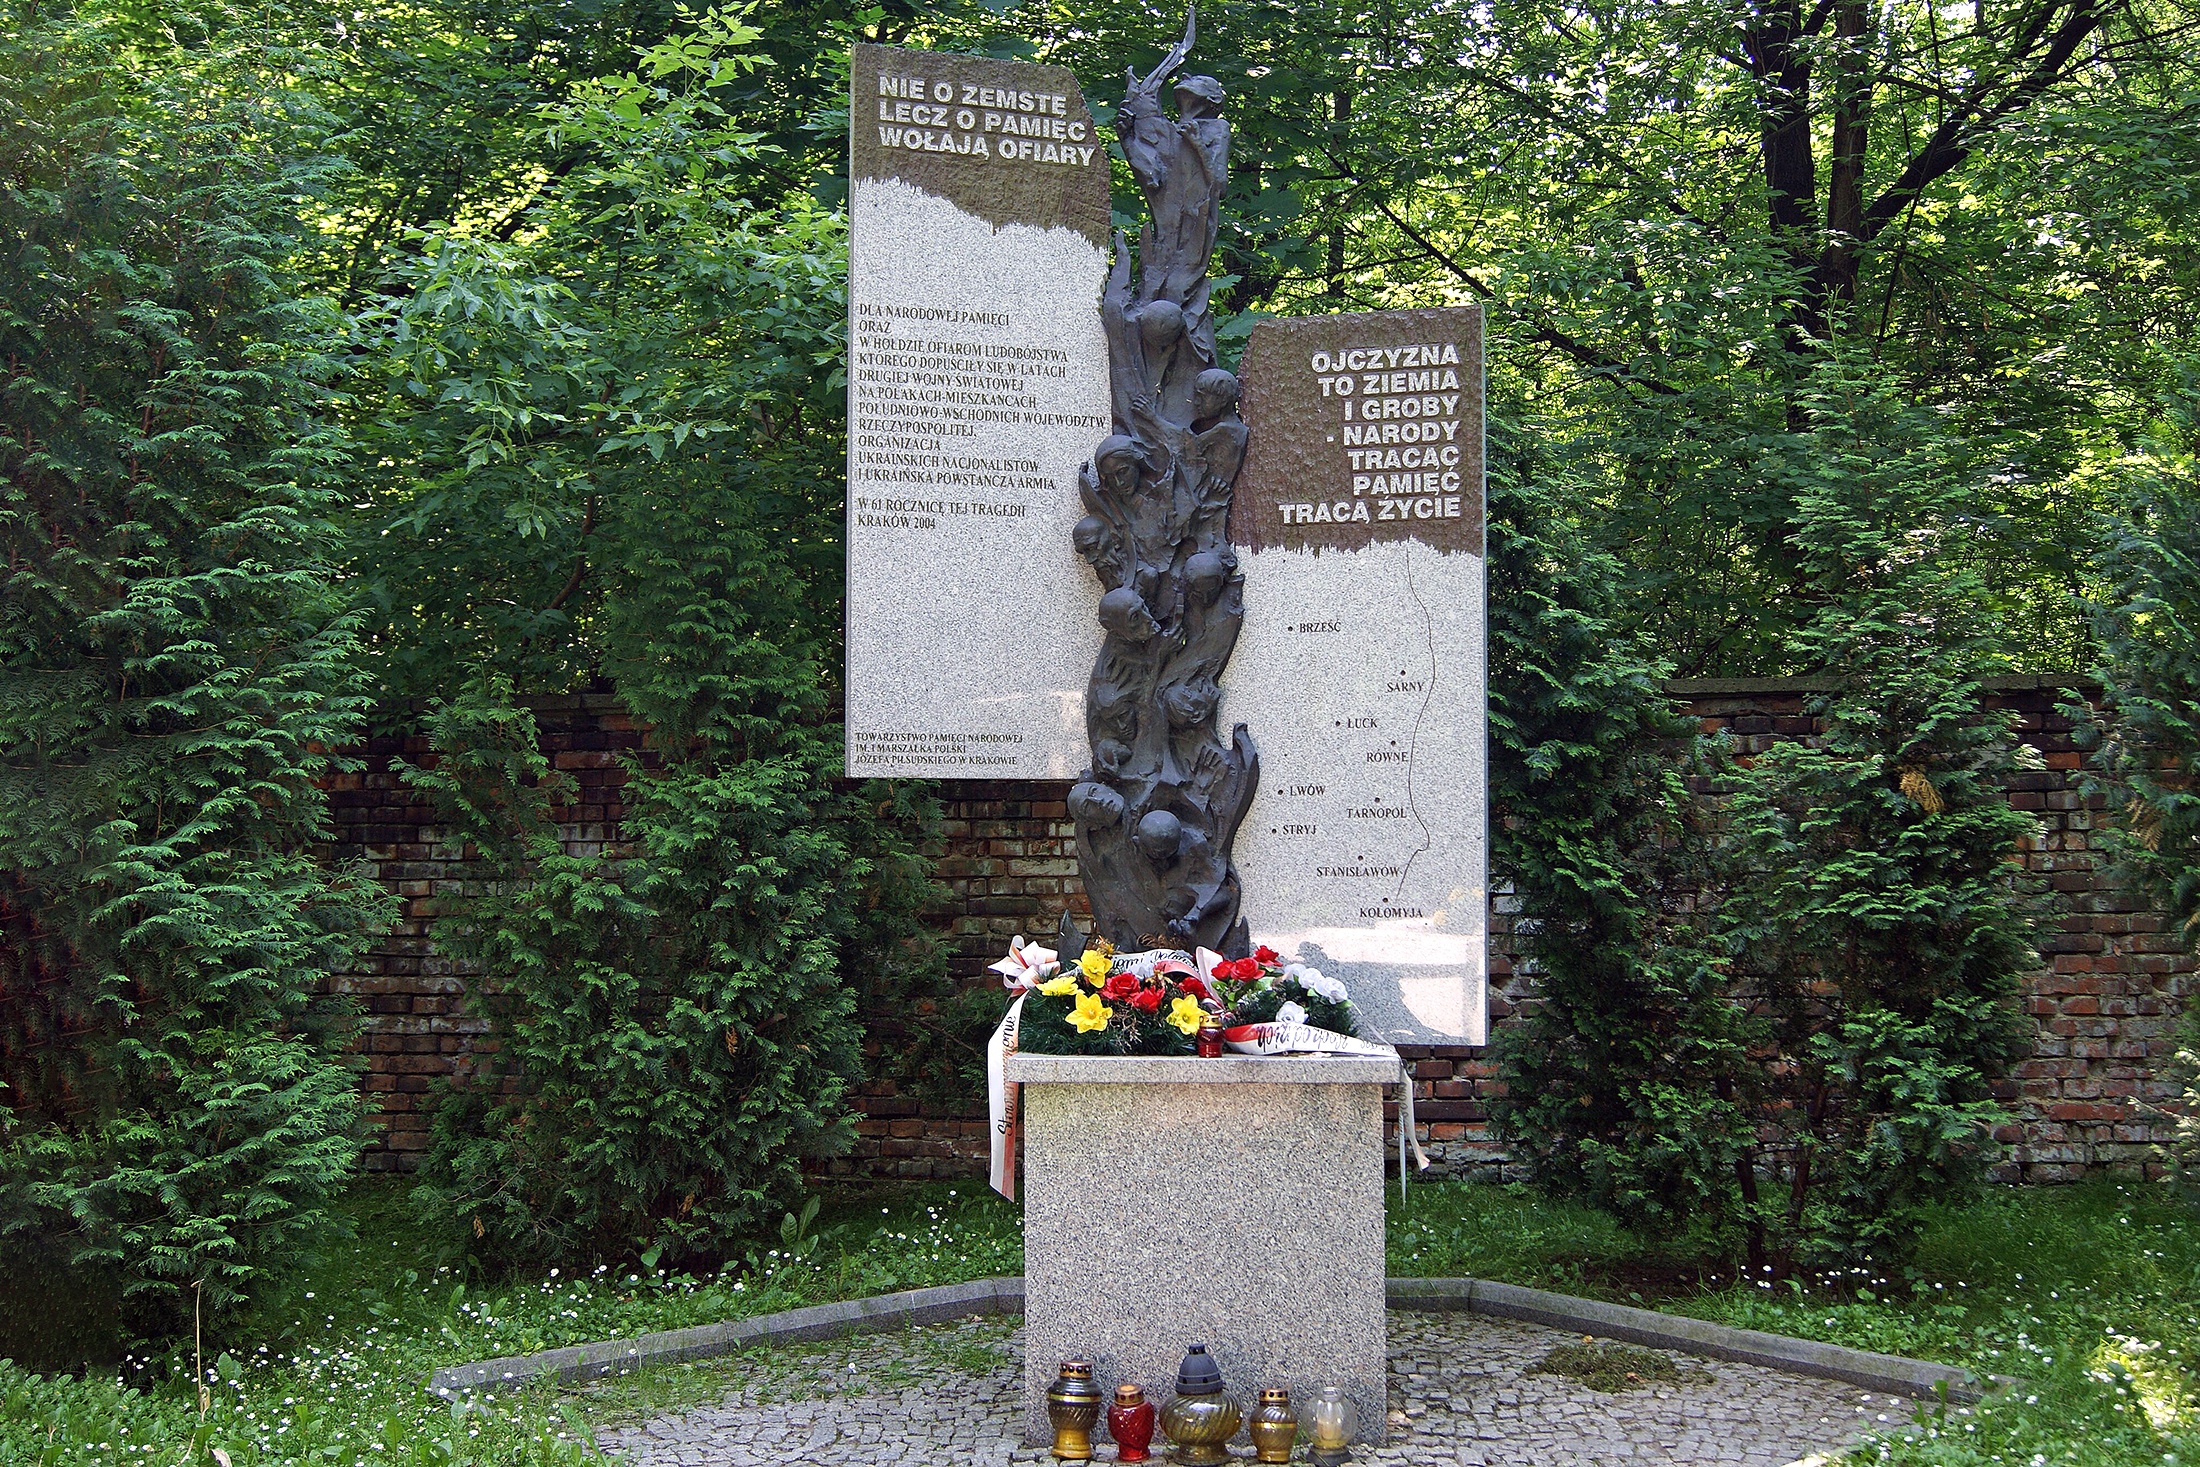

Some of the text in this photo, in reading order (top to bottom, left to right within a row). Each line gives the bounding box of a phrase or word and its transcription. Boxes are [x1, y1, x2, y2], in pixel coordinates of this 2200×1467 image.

[879, 76, 1067, 118] NIE O ZEMSTĘ
[879, 101, 948, 127] LECZ
[956, 110, 976, 130] O
[879, 126, 1095, 167] WOŁAJĄ OFIARY
[860, 303, 882, 317] DLA
[886, 305, 959, 322] NARODOWEJ
[859, 320, 892, 334] ORAZ
[859, 336, 1068, 363] W HOŁDZIE OFIAROM LUDOBÓJSTWA
[1311, 344, 1460, 373] OJCZYZNA
[859, 351, 1066, 378] KTÓREGO DOPUŚCIŁY SIĘ W LATACH
[859, 369, 1024, 391] DRUGIEJ WOJNY ŚWIATOWEJ
[1318, 370, 1460, 397] TO ZIEMIA
[859, 386, 874, 398] NA
[1344, 395, 1459, 421] I GROBY
[1343, 420, 1460, 446] NARODY
[859, 434, 940, 451] ORGANIZACJA
[865, 466, 933, 484] UKRAIŃSKA
[1353, 466, 1461, 496] PAMIĘĆ
[858, 498, 1025, 517] W 61 ROCZNICĘ TEJ TRAGEDII
[1278, 501, 1370, 524] TRACĄ
[858, 513, 936, 529] KRAKÓW 2004
[1300, 618, 1341, 632] BRZEŚĆ
[1387, 682, 1425, 693] SARNY
[855, 732, 926, 742] TOWARZYSTWO
[968, 734, 1023, 743] NARODOWEJ
[935, 745, 966, 753] POLSKI
[1367, 748, 1408, 762] RÓWNE
[855, 753, 1018, 765] JÓZEFA PIŁSUDSKIEGO W KRAKOWIE
[1290, 783, 1326, 796] LWÓW
[1347, 808, 1407, 819] TARNOPOL
[1282, 825, 1317, 836] STRYJ
[1316, 864, 1399, 877] STANISŁAWÓW
